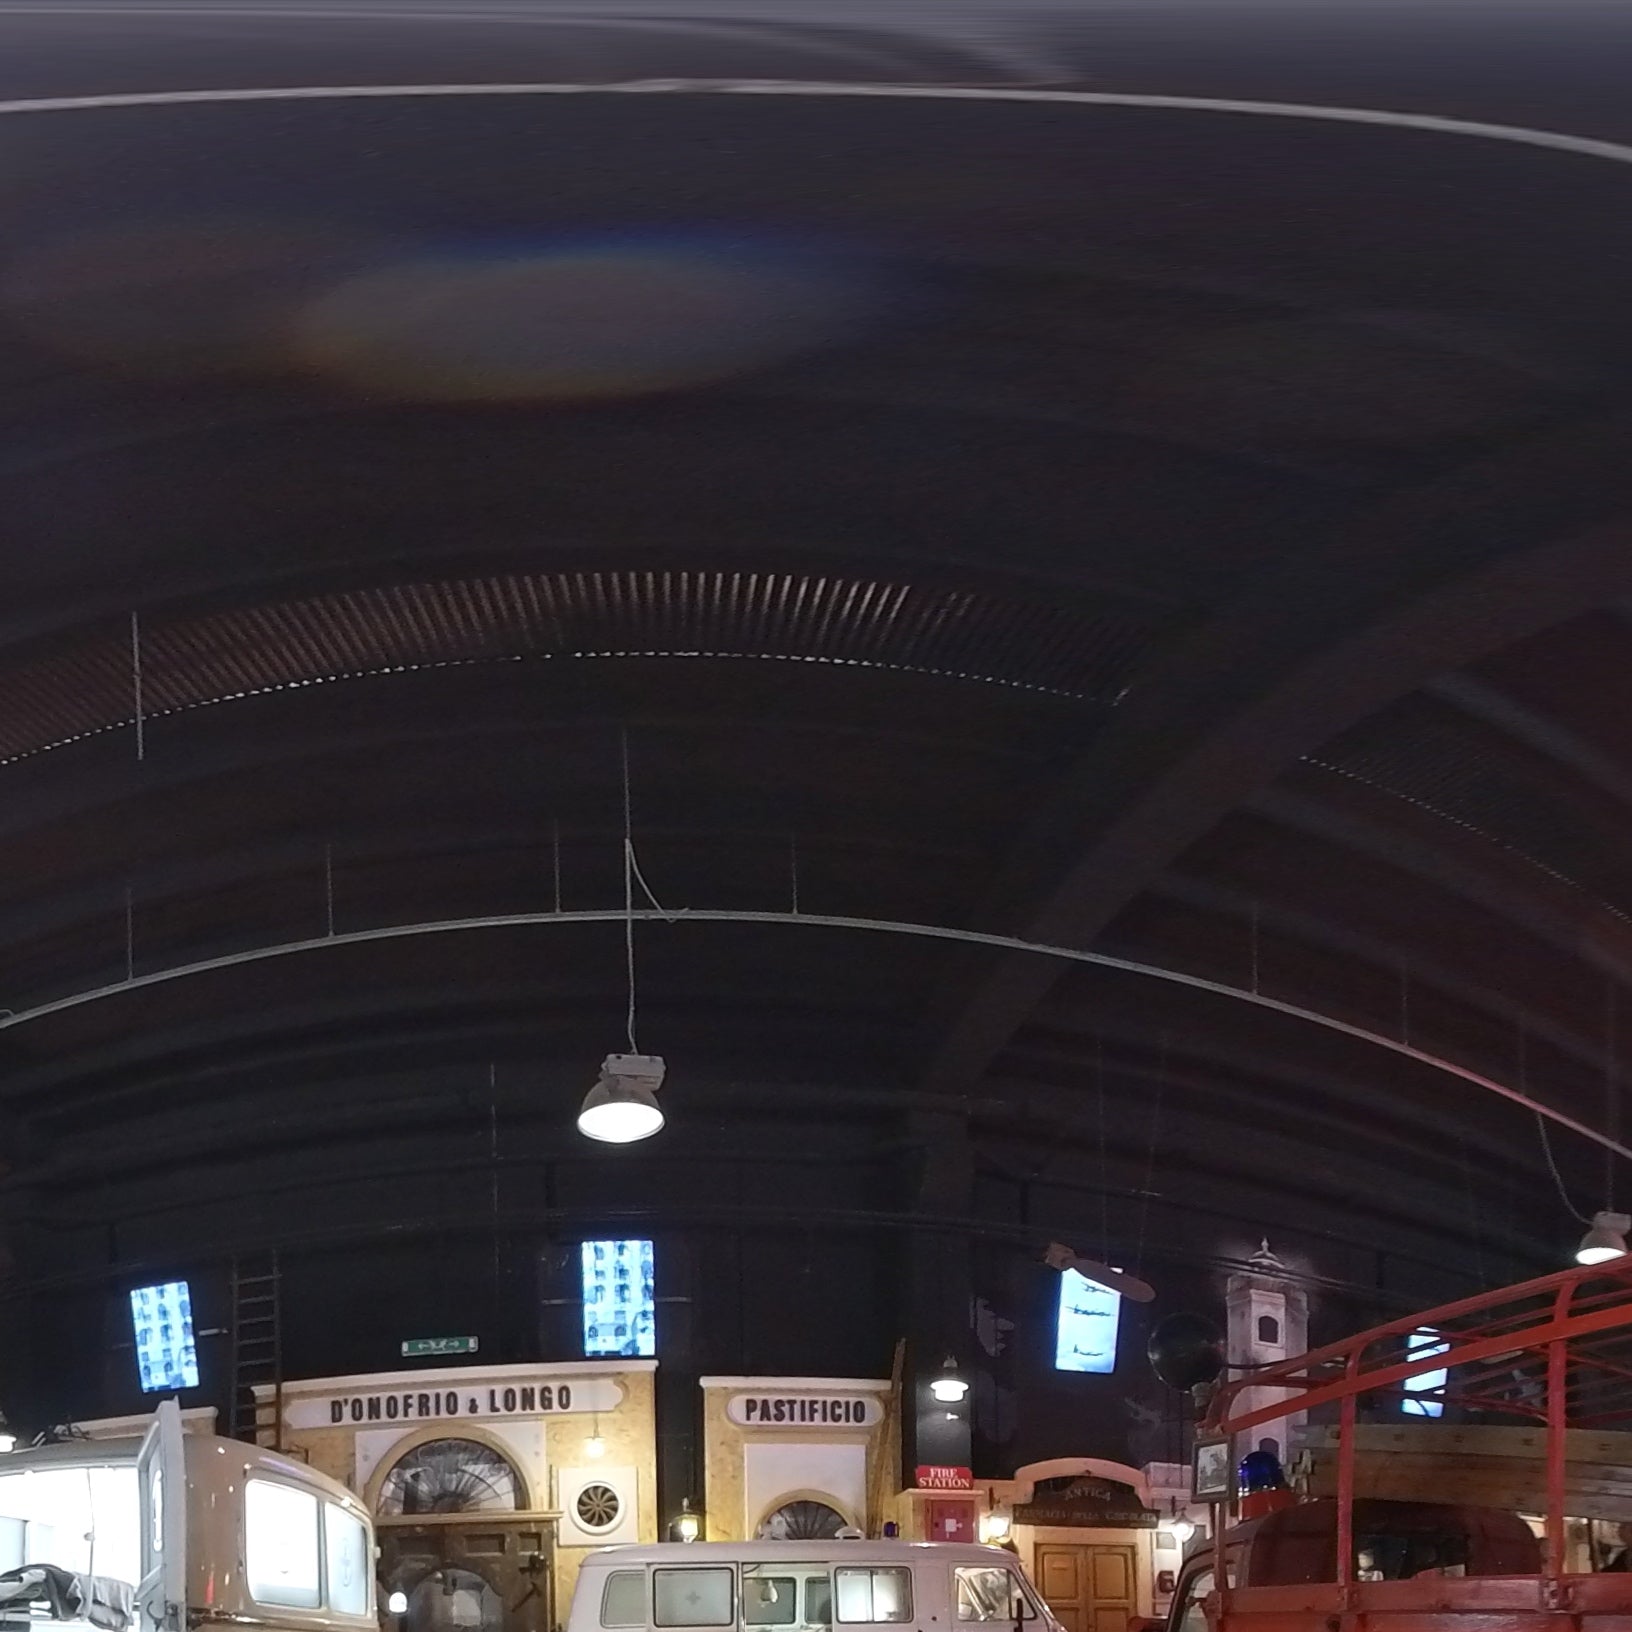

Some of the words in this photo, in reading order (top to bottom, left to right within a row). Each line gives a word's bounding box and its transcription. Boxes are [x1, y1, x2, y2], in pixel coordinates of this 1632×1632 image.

[331, 1391, 458, 1423] D'ONOFRIO
[468, 1398, 479, 1414] &
[489, 1385, 572, 1413] LONGO
[746, 1398, 866, 1423] PASTIFICIO
[930, 1468, 957, 1478] FIRE
[919, 1477, 970, 1488] STATION
